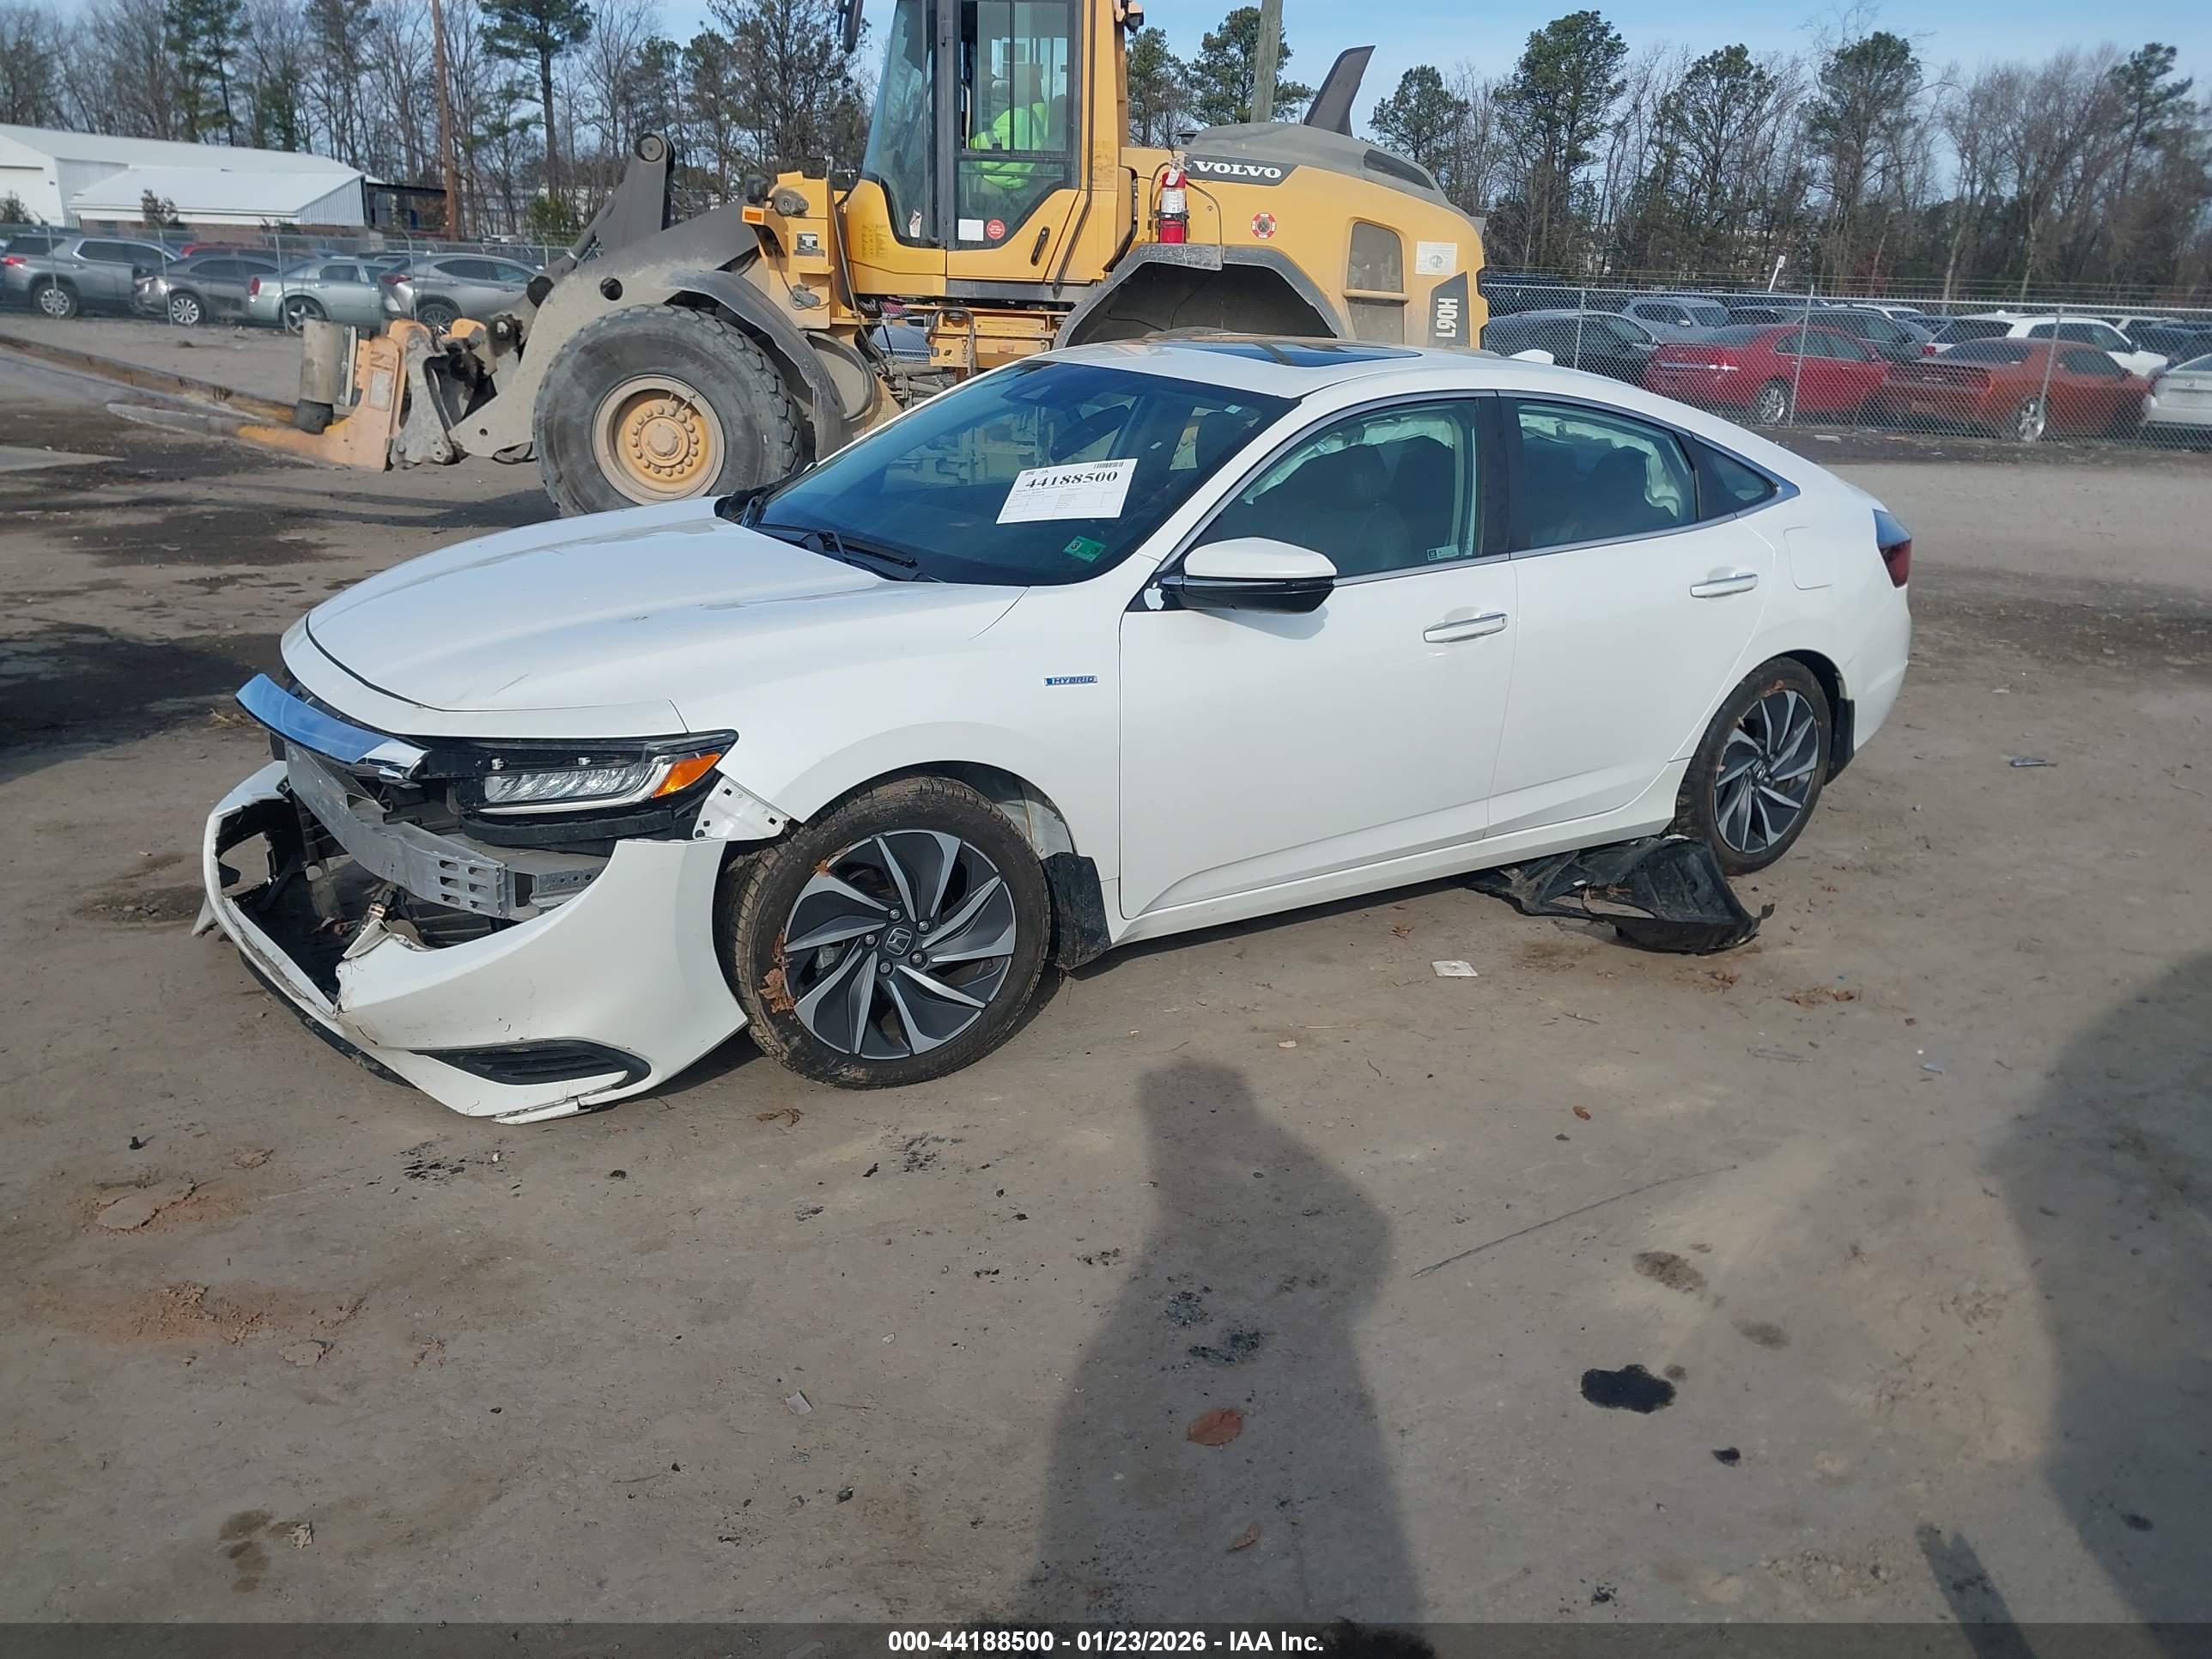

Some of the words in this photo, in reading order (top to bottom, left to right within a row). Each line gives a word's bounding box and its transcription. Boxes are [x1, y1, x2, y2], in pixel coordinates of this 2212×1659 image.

[1193, 161, 1281, 178] VOLVO
[1436, 298, 1458, 337] L90H
[1026, 471, 1118, 488] 44188500
[1054, 676, 1095, 685] HYBRID
